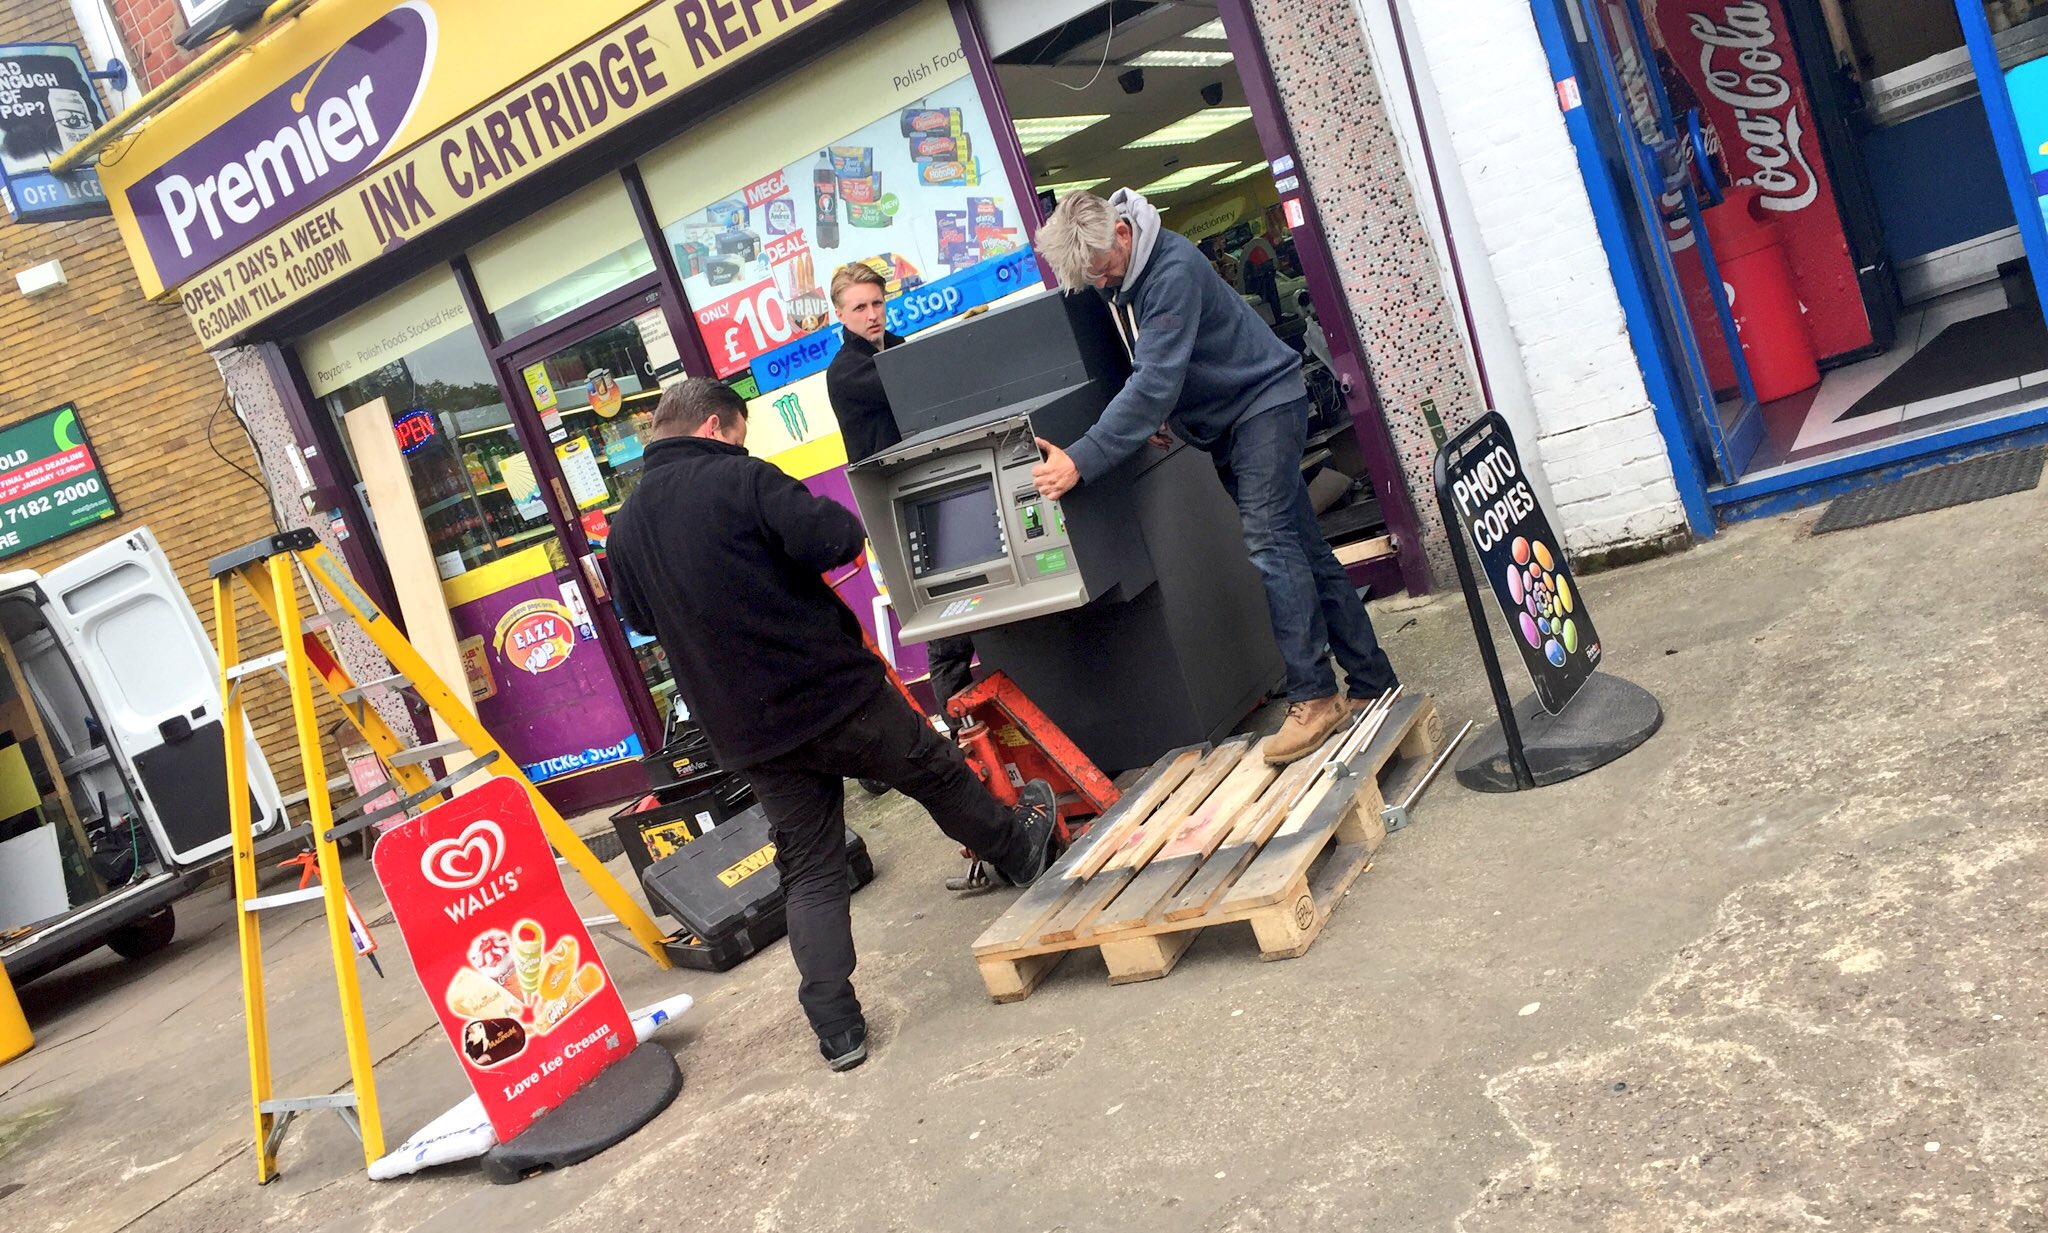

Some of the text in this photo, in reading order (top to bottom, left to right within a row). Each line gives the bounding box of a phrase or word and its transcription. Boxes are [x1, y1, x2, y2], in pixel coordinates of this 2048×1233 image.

[0, 62, 21, 77] AD
[0, 73, 59, 91] NOUGH
[893, 63, 932, 92] Polish
[0, 101, 46, 120] POP?
[359, 24, 668, 245] INK CARTRIDGE
[155, 75, 380, 260] Premier
[23, 183, 57, 206] OFF
[747, 174, 788, 205] MEGA
[882, 199, 898, 210] NEW
[1183, 210, 1235, 239] onfectionery
[184, 207, 344, 315] OPEN 7 DAYS A WEEK
[767, 230, 808, 263] DEALS
[198, 238, 352, 340] 6:30AM TILL 10:00PM
[903, 286, 960, 321] Stop
[699, 302, 730, 325] ONLY
[787, 297, 829, 316] KRAVE
[724, 286, 793, 364] £10
[318, 303, 464, 384] Payzone Polish Foods Stocked Here
[768, 338, 829, 379] oyster
[0, 449, 28, 471] OLD
[1, 450, 84, 489] FINAL BIDS DEADLINE
[22, 473, 54, 490] JANUARY
[56, 462, 86, 477] 12.00pm
[1452, 445, 1516, 517] PHOTO
[5, 496, 52, 524] 7182
[53, 478, 99, 506] 2000
[1473, 480, 1535, 552] COPIES
[0, 531, 20, 550] RE
[513, 619, 556, 650] EAZY
[524, 642, 555, 676] POP
[443, 871, 519, 925] WALL'S
[487, 1026, 518, 1050] MAGNUM
[503, 1023, 611, 1102] Love Ice Cream
